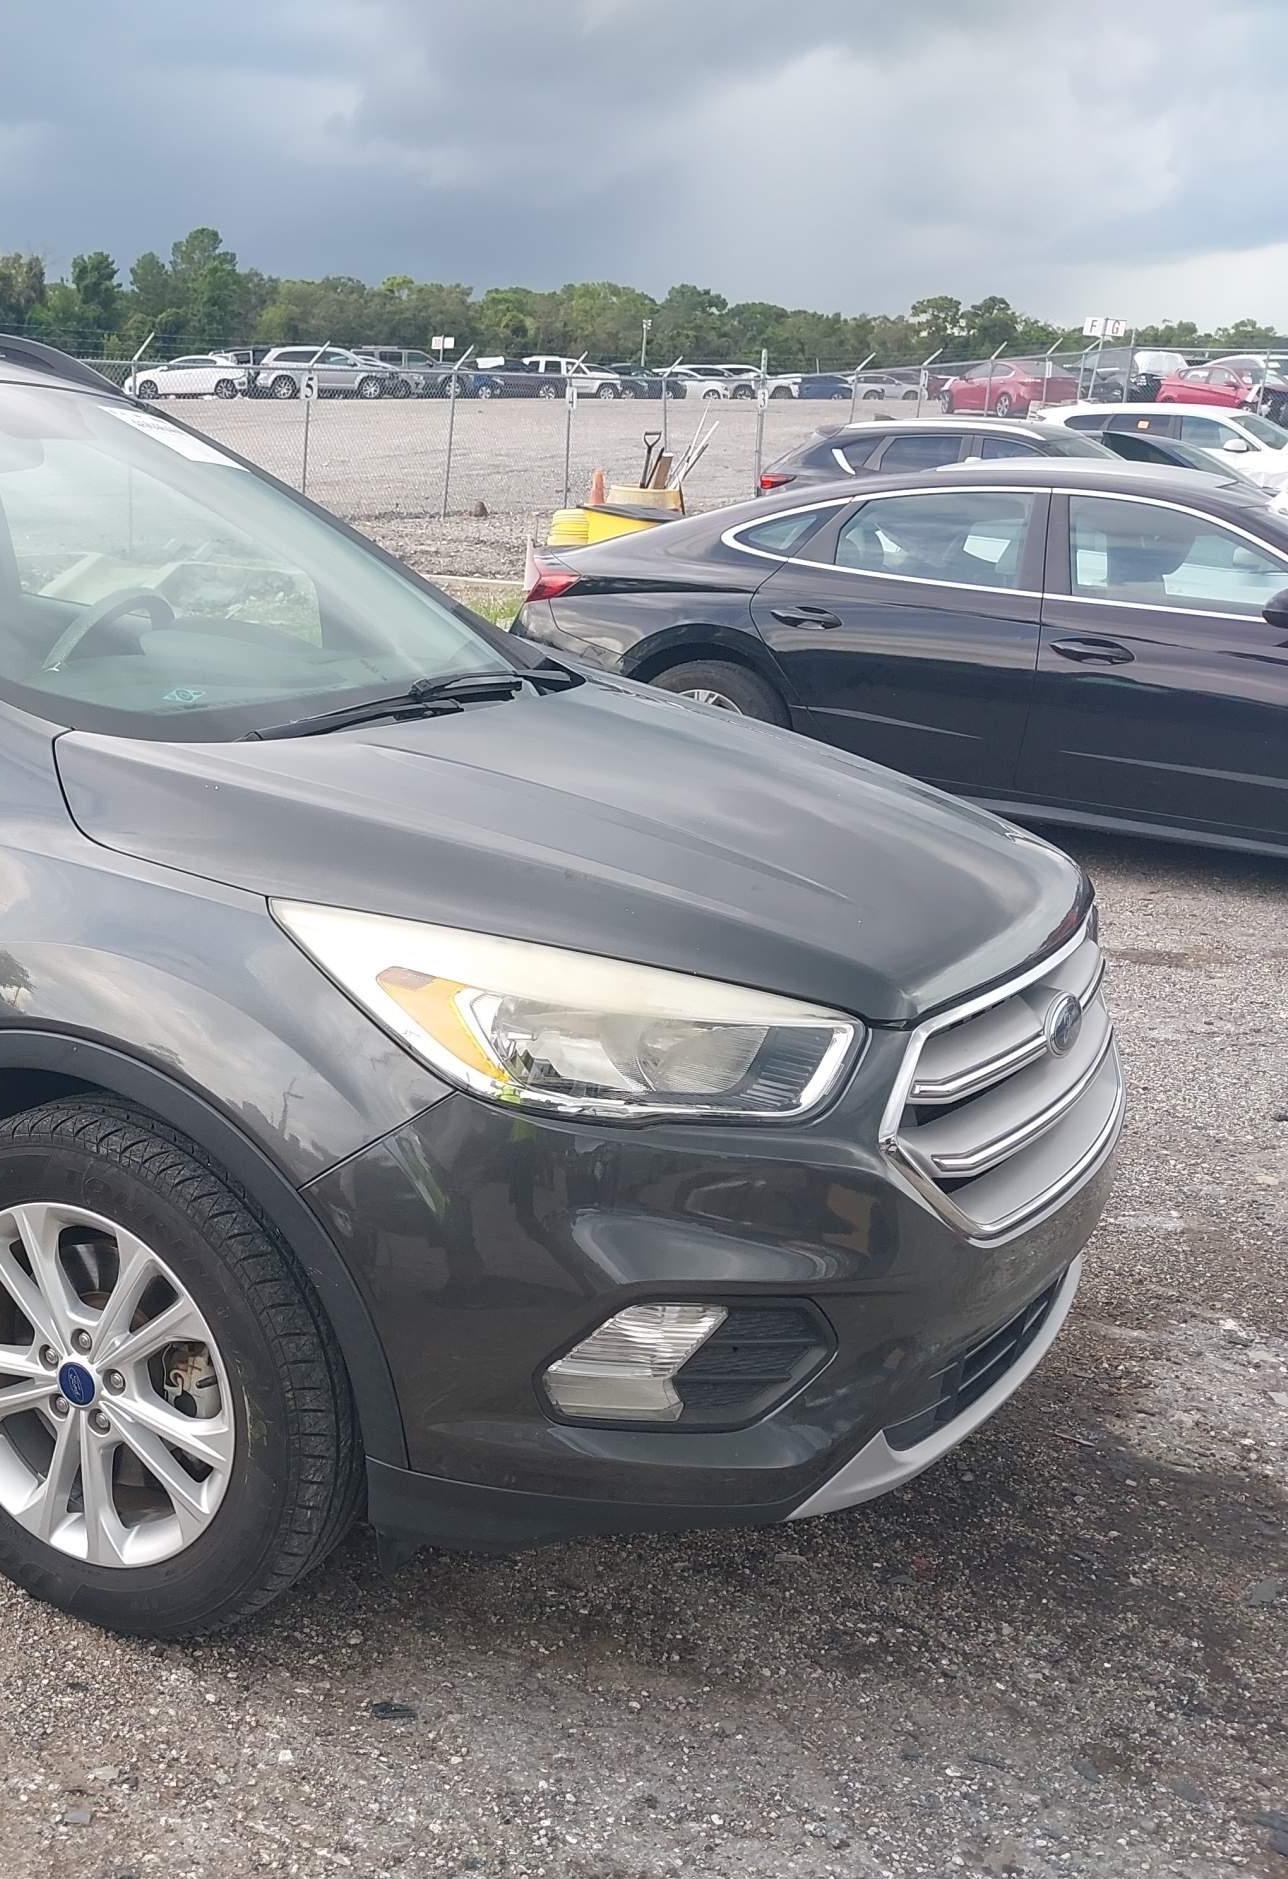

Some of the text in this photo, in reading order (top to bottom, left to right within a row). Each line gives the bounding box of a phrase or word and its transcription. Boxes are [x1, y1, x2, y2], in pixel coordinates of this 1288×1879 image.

[1089, 319, 1098, 334] F
[1111, 319, 1121, 335] G
[304, 376, 314, 398] 5
[759, 391, 767, 408] 3
